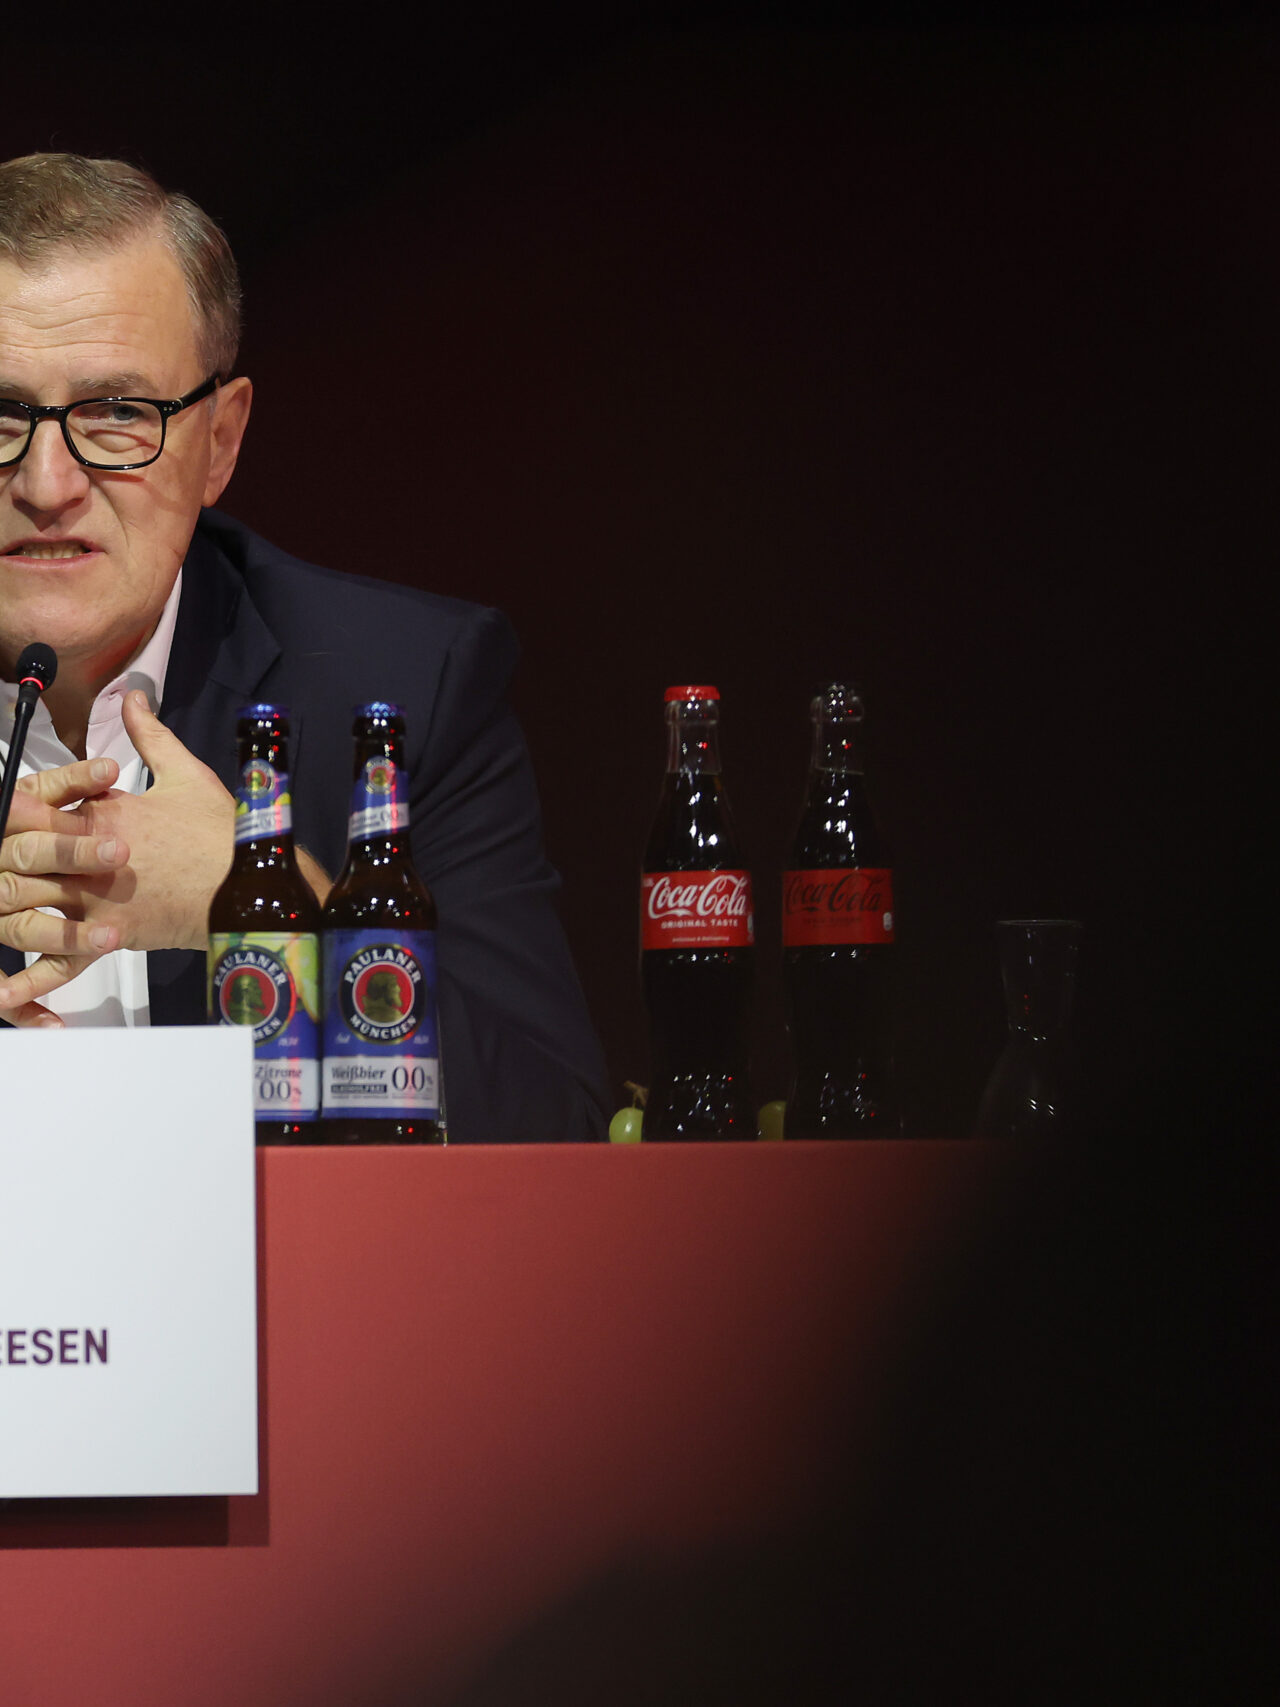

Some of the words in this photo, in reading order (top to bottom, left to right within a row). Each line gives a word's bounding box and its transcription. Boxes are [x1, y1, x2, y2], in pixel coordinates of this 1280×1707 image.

[648, 874, 748, 919] Coca-Cola
[661, 919, 707, 930] ORIGINAL
[711, 918, 739, 928] TASTE
[214, 952, 287, 987] PAULANER
[344, 948, 422, 984] PAULANER
[349, 1013, 418, 1040] MÜNCHEN
[255, 1064, 302, 1081] Zitrone
